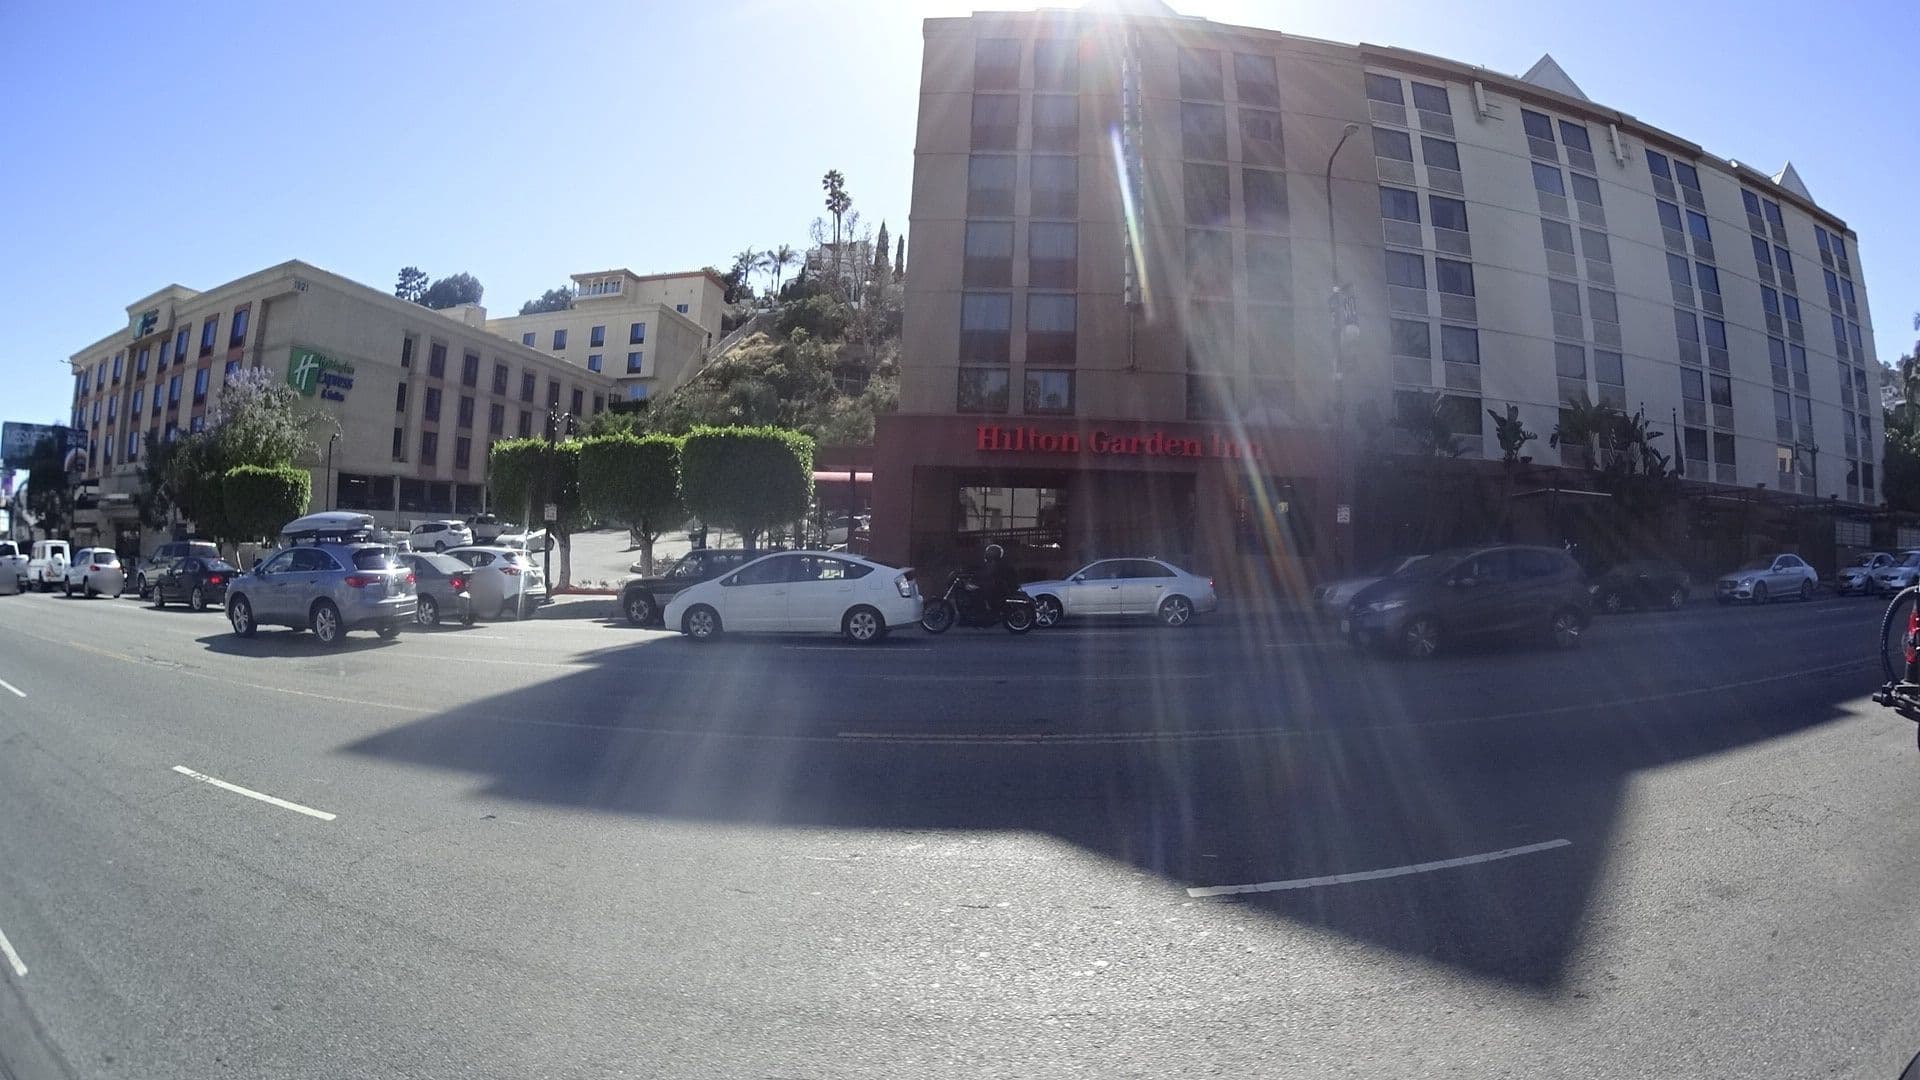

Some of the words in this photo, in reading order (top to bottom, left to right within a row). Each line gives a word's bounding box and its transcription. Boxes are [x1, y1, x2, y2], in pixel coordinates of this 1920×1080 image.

[317, 368, 354, 391] Express
[977, 424, 1080, 453] Hilton
[1088, 429, 1201, 457] Garden
[1212, 432, 1263, 459] Inn
